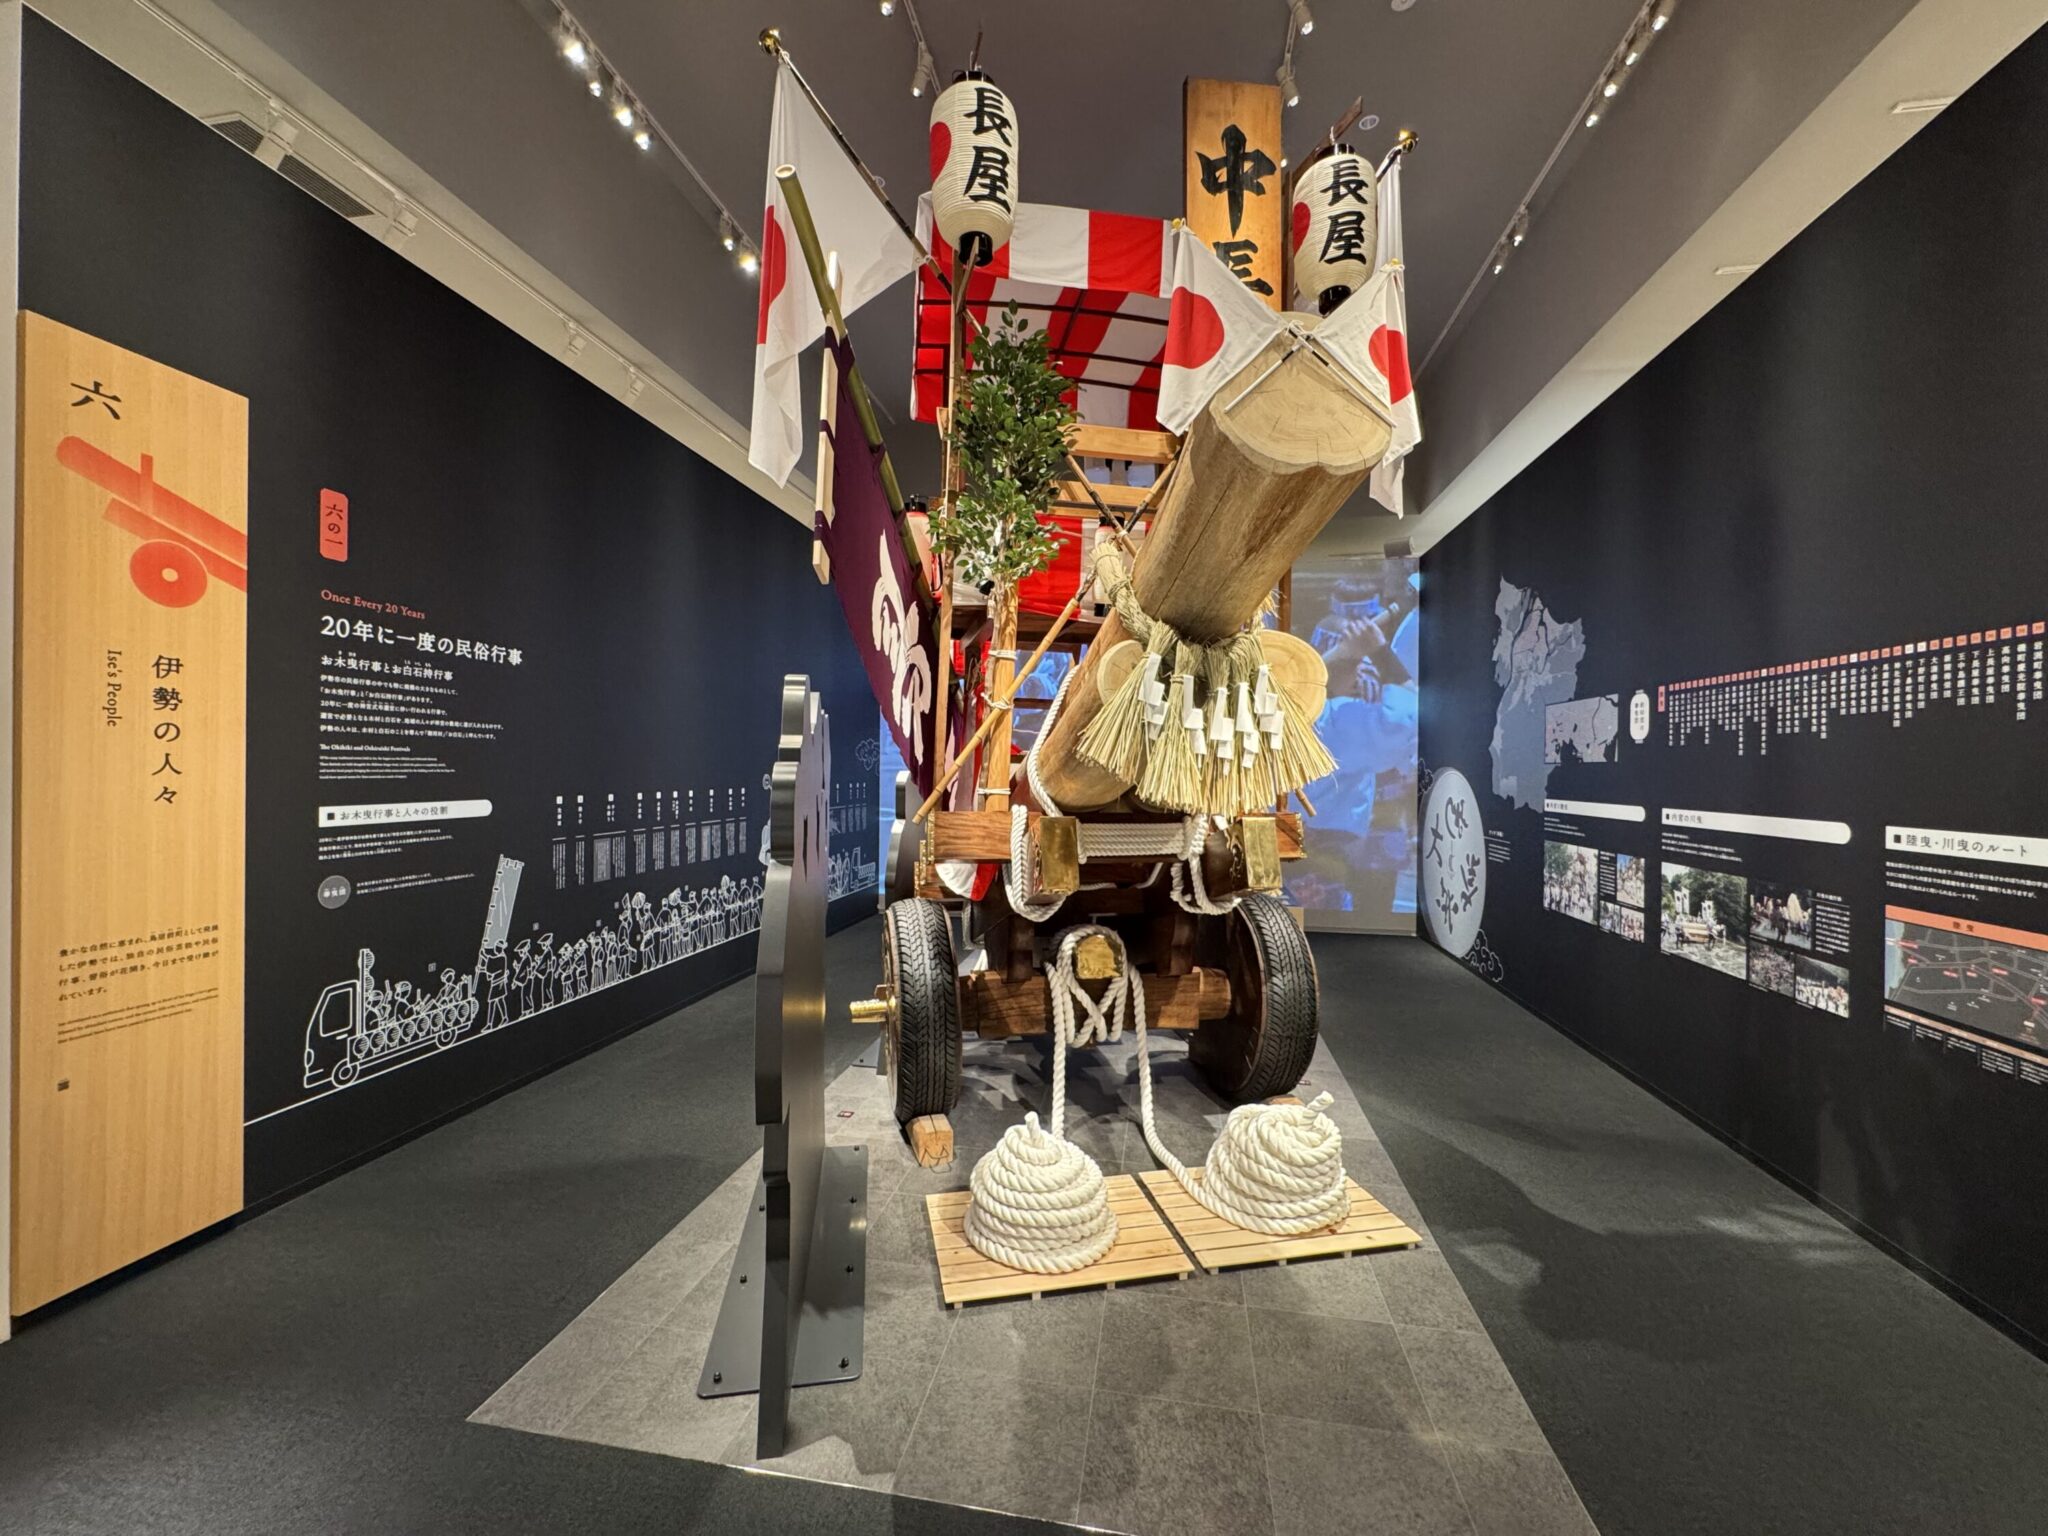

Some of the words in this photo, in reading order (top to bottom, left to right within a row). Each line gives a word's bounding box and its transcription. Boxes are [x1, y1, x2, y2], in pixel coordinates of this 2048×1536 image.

[963, 87, 1012, 214] 長屋
[1319, 159, 1368, 265] 長屋
[70, 380, 122, 420] 六
[325, 504, 343, 545] 六の一
[320, 589, 351, 605] Once
[354, 596, 383, 613] Every
[386, 603, 398, 614] 20
[400, 606, 426, 620] Years
[320, 615, 523, 666] 20年に一度の民俗行事
[107, 648, 122, 679] Ise's
[321, 655, 454, 681] お木曳行事とお白石持行事
[102, 682, 122, 728] People
[151, 655, 184, 805] 伊勢の人々
[340, 806, 449, 821] お木曳行事と人々の役割
[1906, 833, 2028, 858] 陸曳・川曳のルート
[59, 987, 107, 1001] れています。
